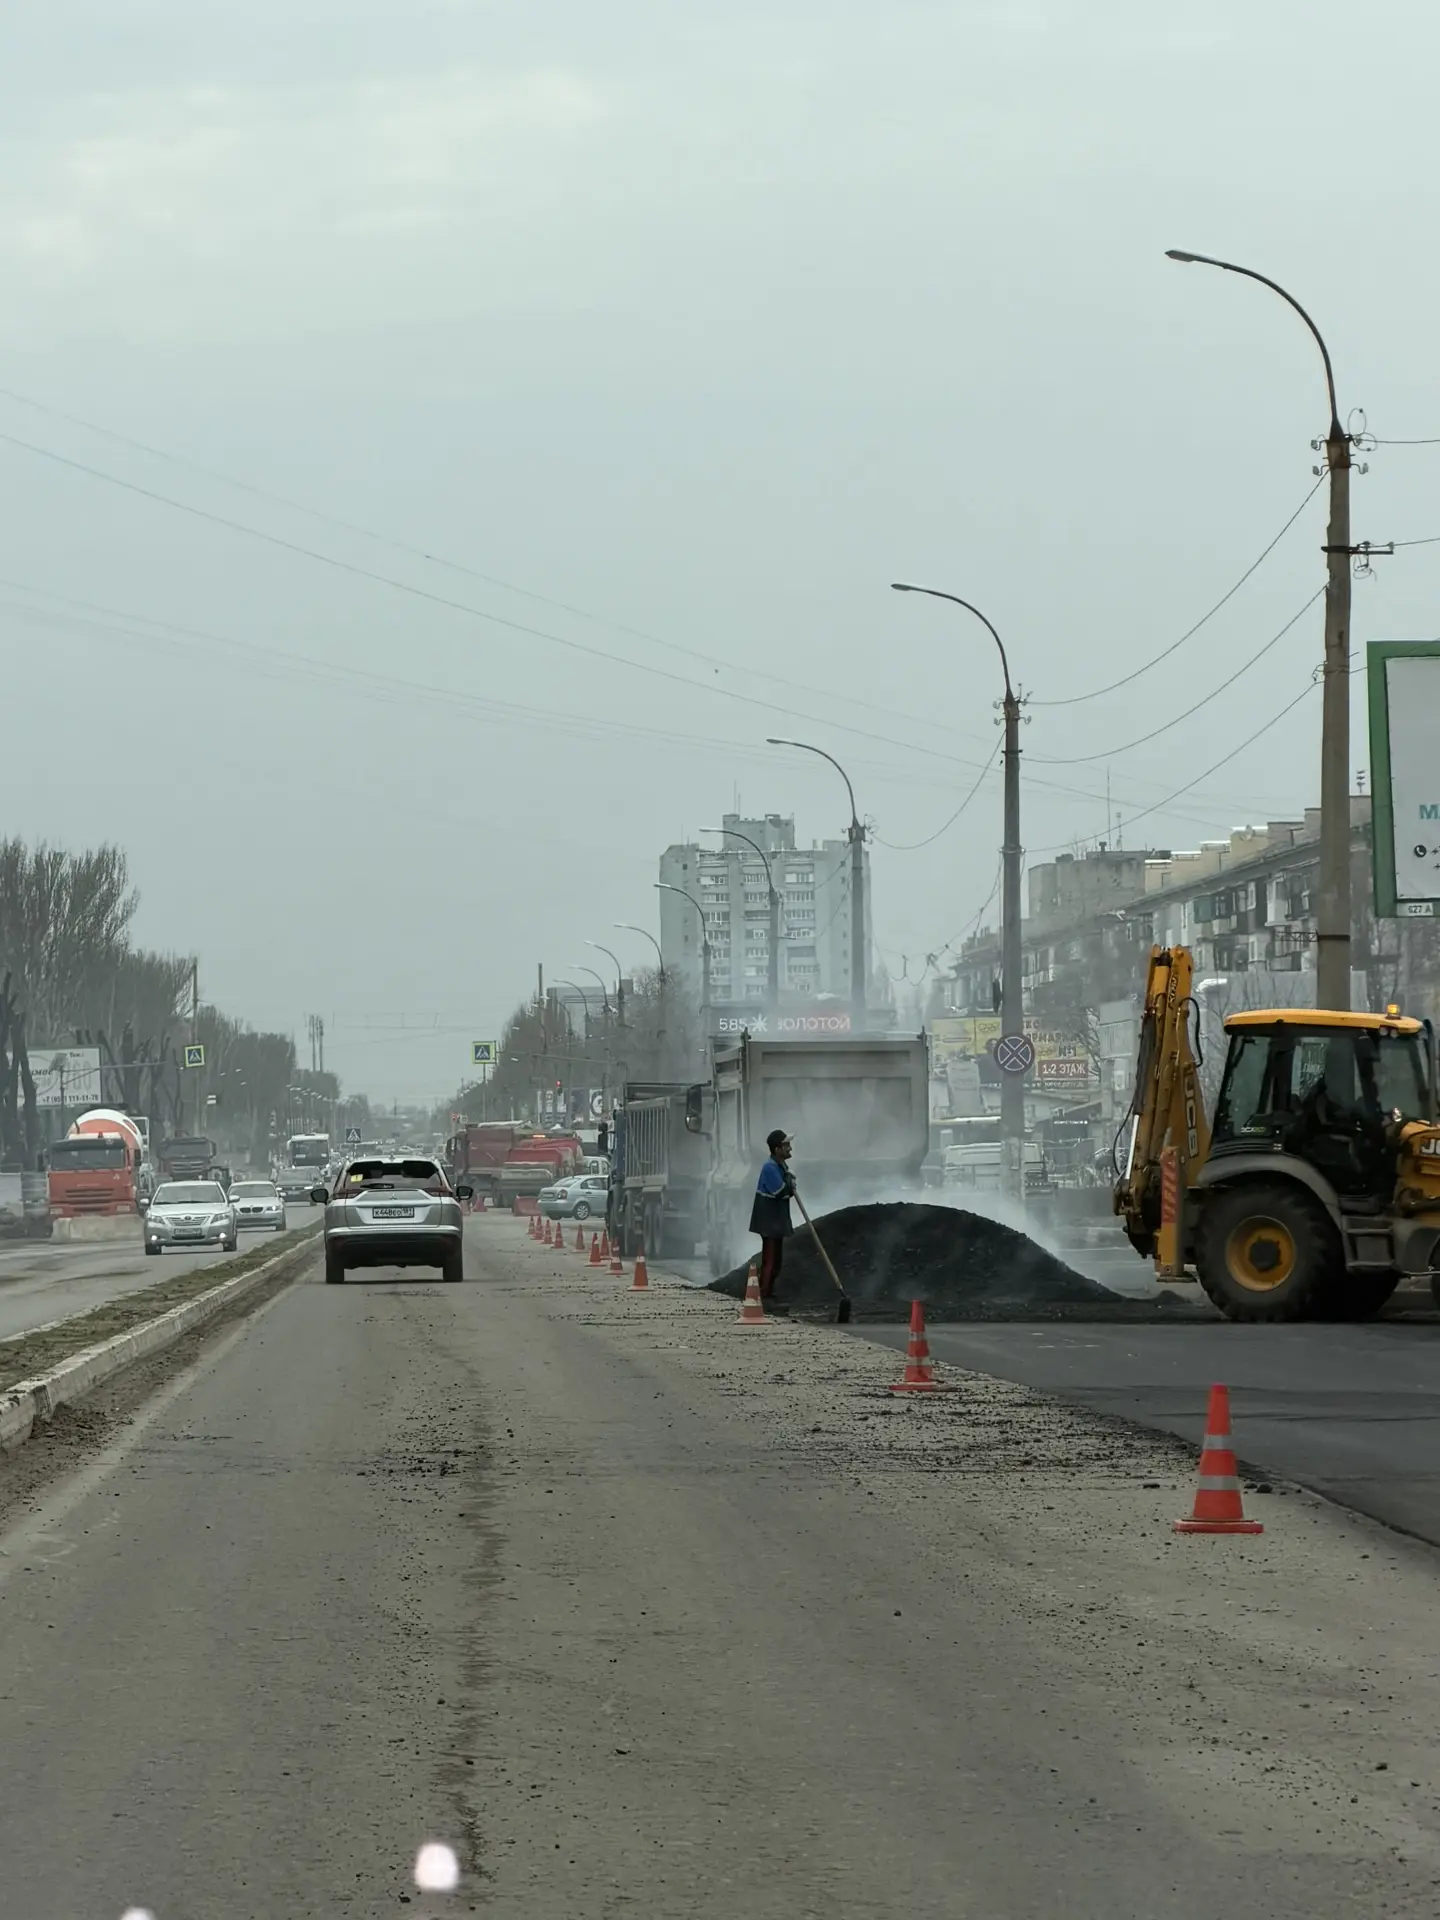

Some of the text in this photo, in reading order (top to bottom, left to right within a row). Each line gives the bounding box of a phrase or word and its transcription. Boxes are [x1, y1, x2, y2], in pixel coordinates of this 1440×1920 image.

[719, 1017, 748, 1031] 585
[1042, 1062, 1086, 1075] 1-2 ЭТАЖ
[1184, 1076, 1199, 1158] JCB
